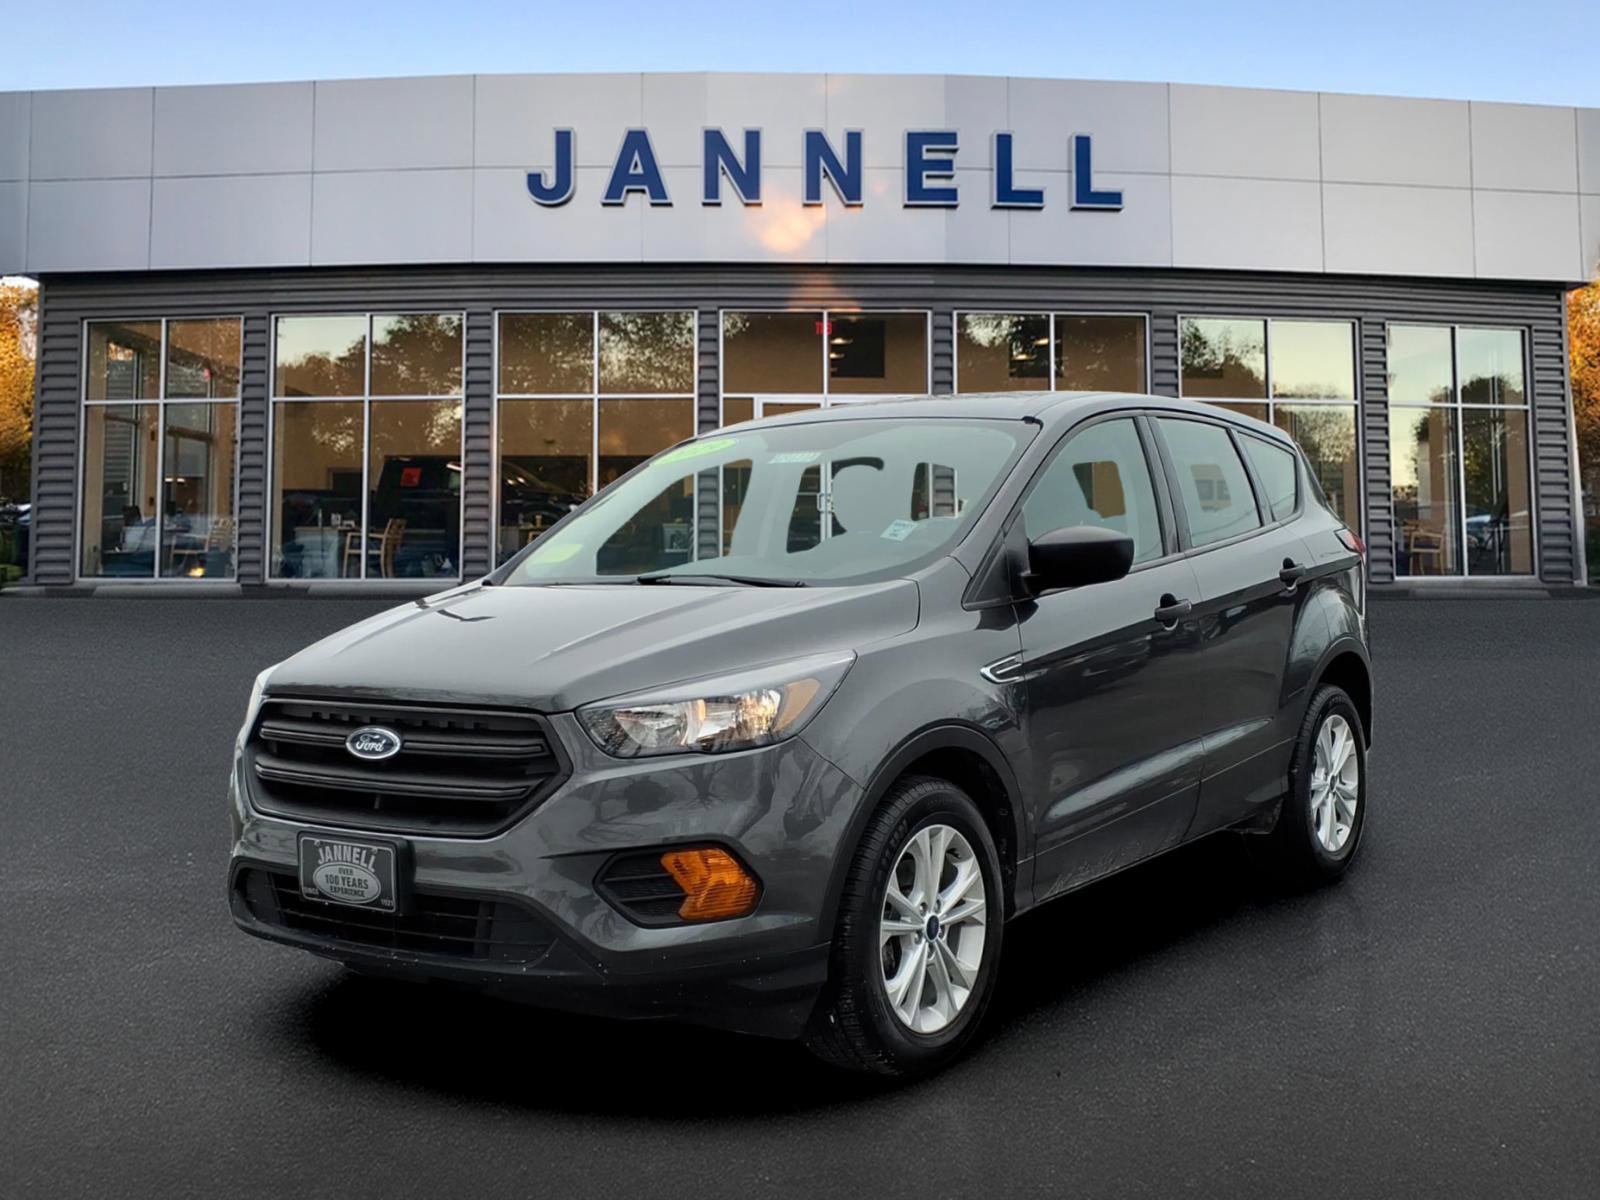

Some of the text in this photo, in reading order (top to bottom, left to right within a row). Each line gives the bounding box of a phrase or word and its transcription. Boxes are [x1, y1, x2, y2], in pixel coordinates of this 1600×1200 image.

[526, 127, 1123, 210] JANNELL
[355, 733, 387, 752] Ford
[318, 845, 376, 873] JANNELL
[325, 874, 369, 890] 100 YEARS
